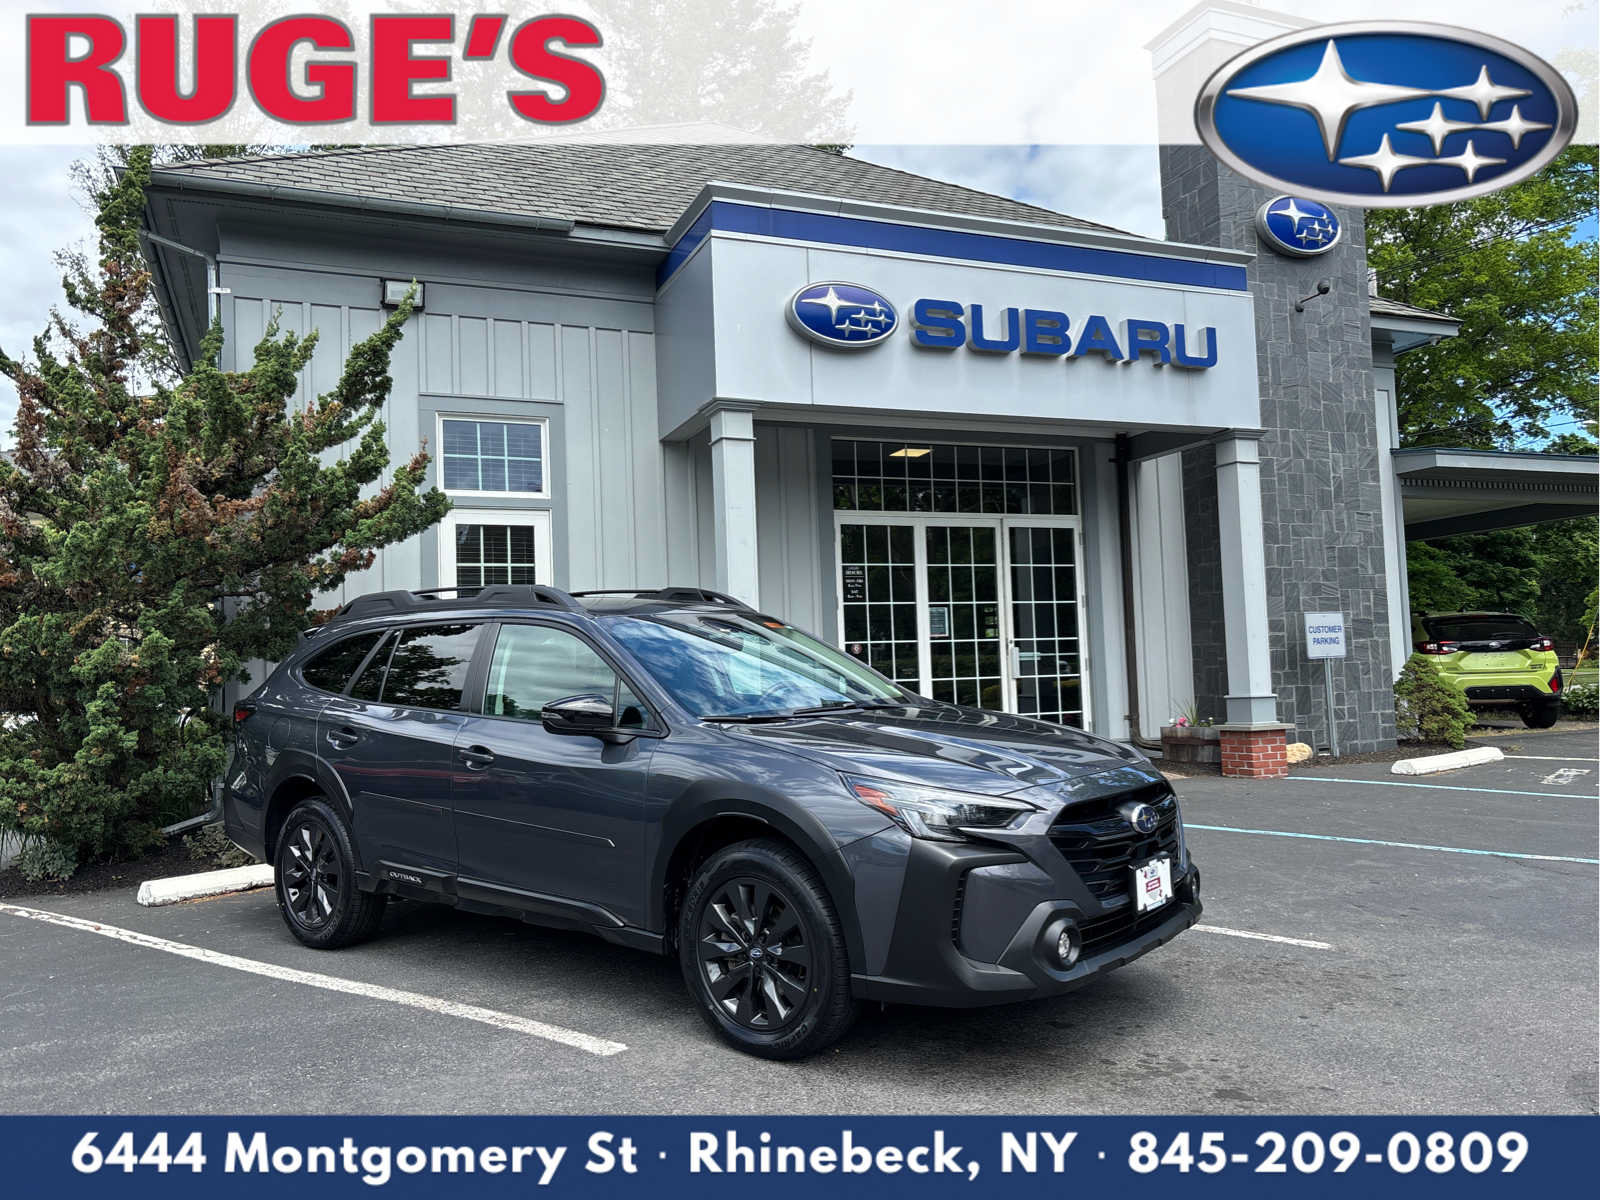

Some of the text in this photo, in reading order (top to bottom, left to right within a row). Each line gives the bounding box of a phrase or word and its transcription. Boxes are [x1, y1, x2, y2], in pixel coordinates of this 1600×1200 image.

[912, 298, 1219, 370] SUBARU
[1308, 625, 1342, 633] CUSTOMER
[1312, 637, 1339, 645] PARKING
[389, 871, 422, 883] OUTBACK
